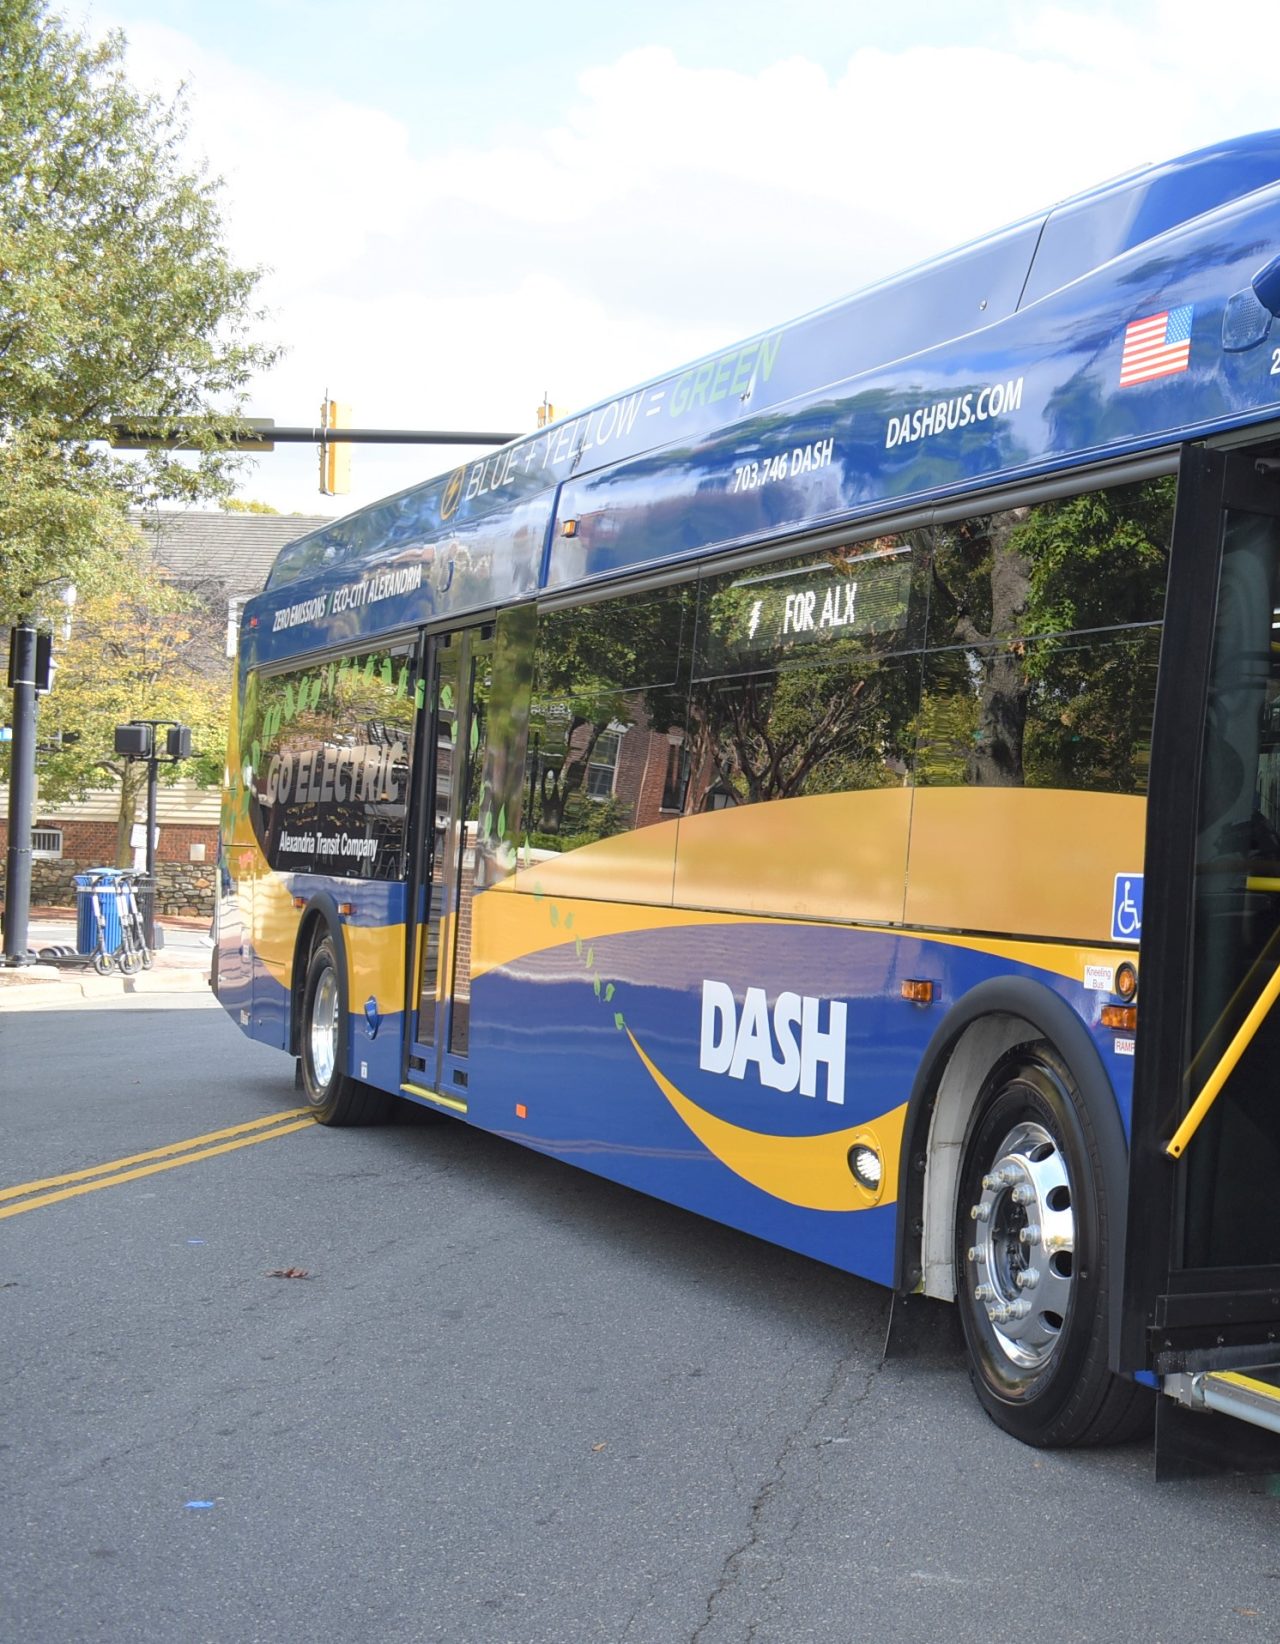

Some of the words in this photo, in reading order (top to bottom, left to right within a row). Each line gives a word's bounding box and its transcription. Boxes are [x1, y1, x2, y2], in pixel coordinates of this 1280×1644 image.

[465, 446, 519, 500] BLUE
[541, 389, 647, 470] YELLOW
[669, 335, 783, 417] GREEN
[886, 376, 1024, 449] DASHBUS.COM
[733, 452, 788, 494] 703.746
[790, 438, 834, 477] DASH
[272, 607, 291, 633] ZERO
[290, 594, 327, 628] EMISSIONS
[332, 580, 370, 614] ECO-CITY
[368, 564, 422, 603] ALEXANDRIA
[783, 590, 816, 634] FOR
[820, 582, 858, 628] ALX
[266, 752, 293, 805] GO
[295, 741, 404, 803] ELECTRIC
[279, 831, 315, 854] Alexandria
[316, 832, 340, 855] Transit
[340, 833, 379, 862] Company
[1086, 967, 1112, 980] Kneeling
[1092, 978, 1104, 989] Bus
[700, 979, 848, 1105] DASH
